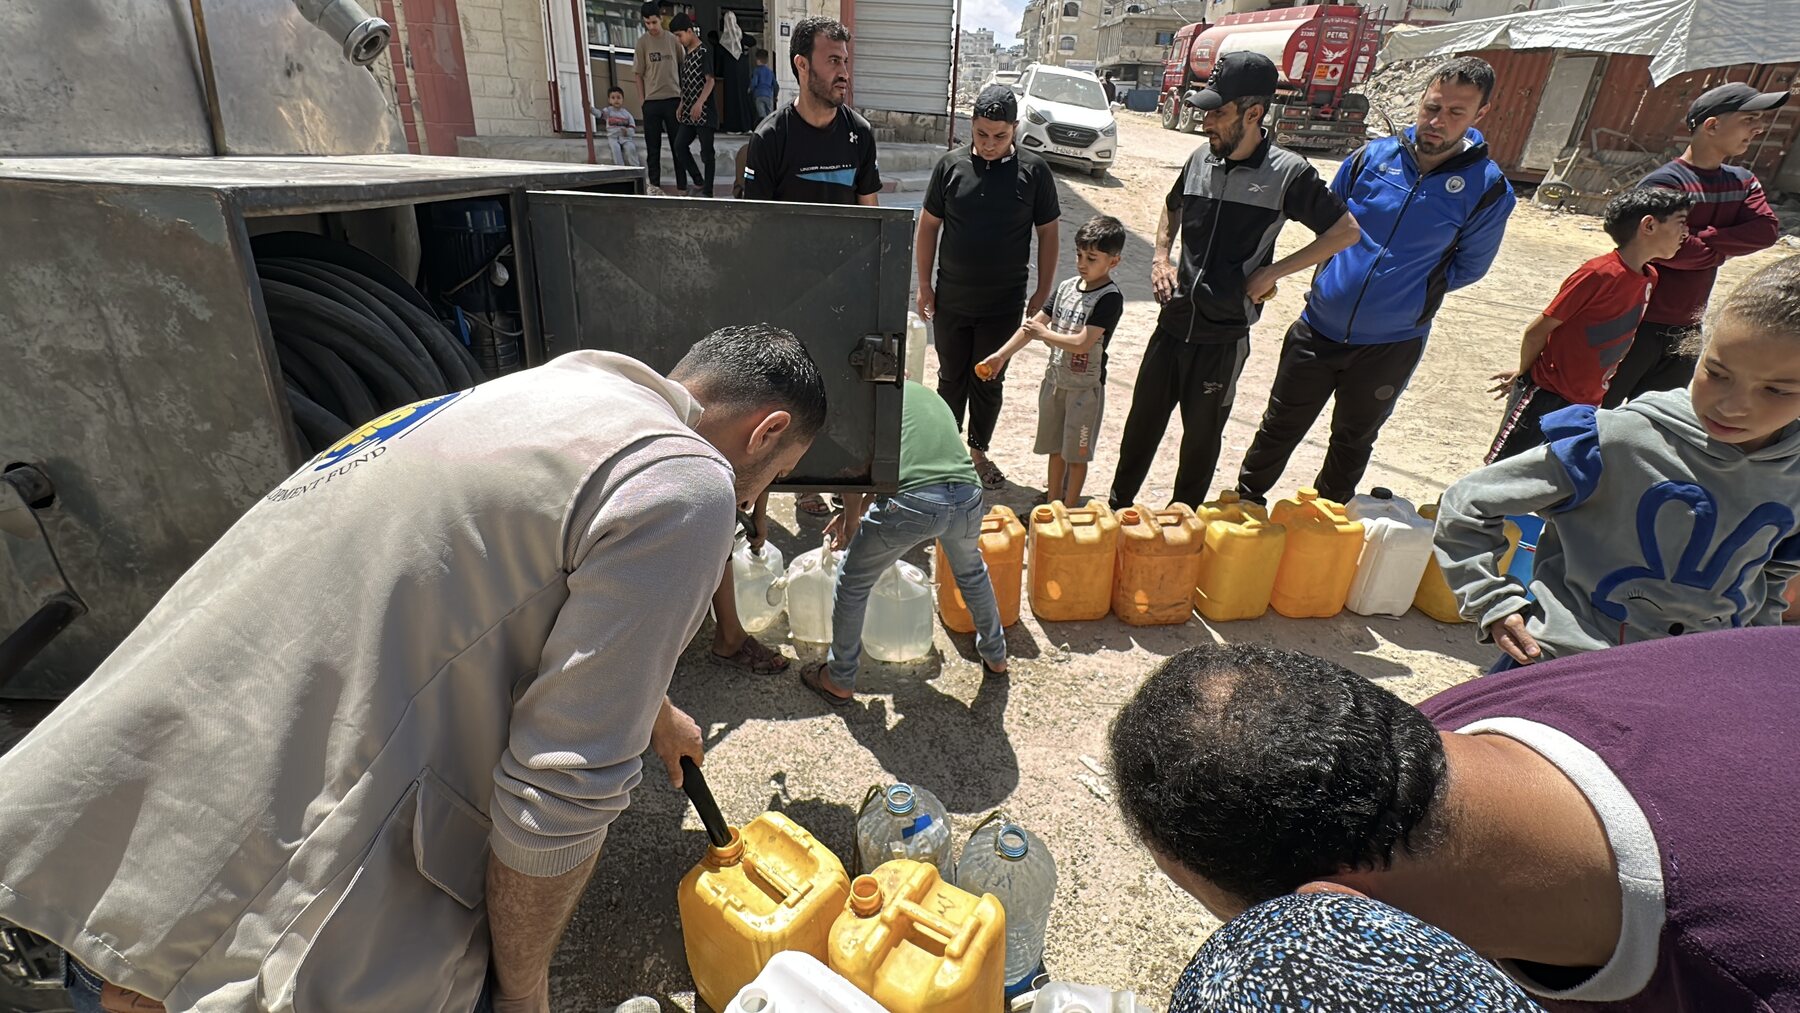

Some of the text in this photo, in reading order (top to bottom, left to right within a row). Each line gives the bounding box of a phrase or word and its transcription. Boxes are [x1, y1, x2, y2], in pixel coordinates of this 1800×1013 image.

[1326, 31, 1349, 39] PETROL
[1055, 307, 1086, 325] SUPER
[325, 446, 387, 484] FUND
